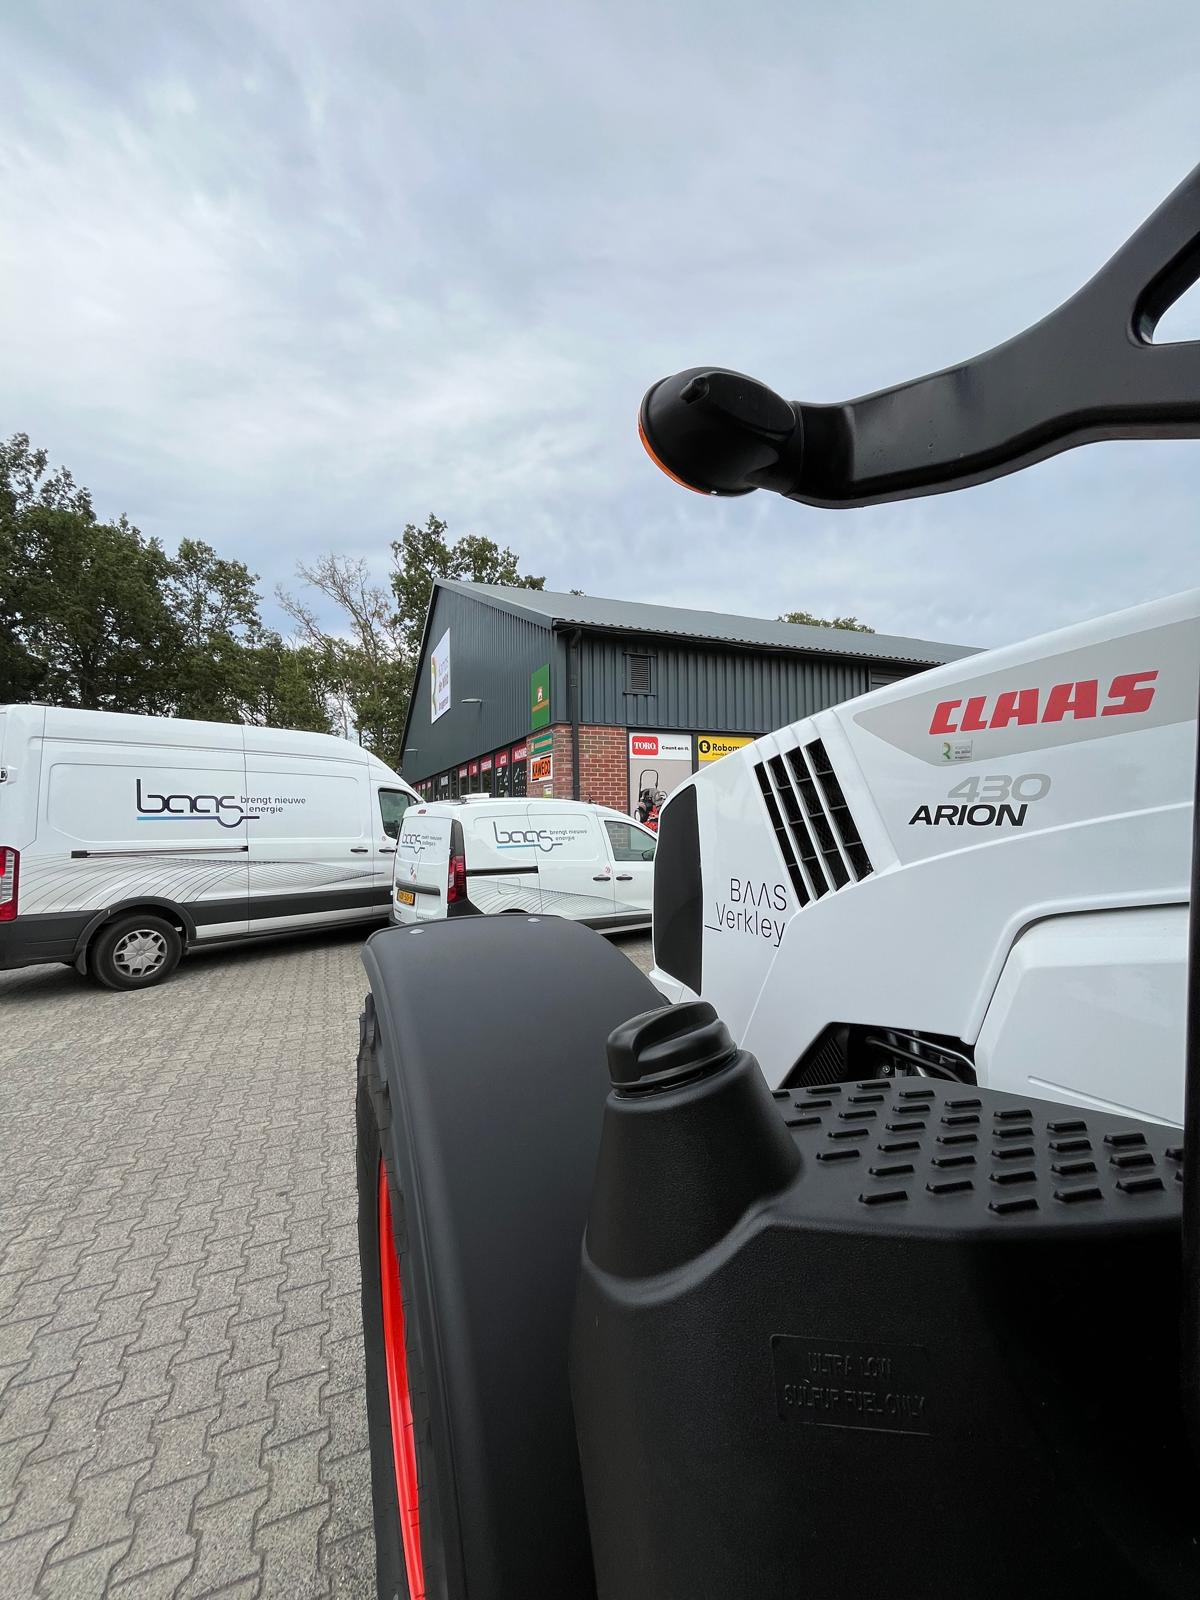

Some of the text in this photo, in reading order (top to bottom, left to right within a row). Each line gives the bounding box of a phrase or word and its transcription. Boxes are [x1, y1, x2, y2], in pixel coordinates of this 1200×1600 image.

[929, 670, 1159, 735] CLAAS
[634, 742, 657, 750] TORO
[136, 778, 306, 814] baas brengt nieuwe
[947, 774, 1051, 802] 430
[249, 806, 284, 814] energie
[908, 804, 1028, 827] ARION
[493, 821, 553, 844] baas
[729, 878, 788, 911] BAAS
